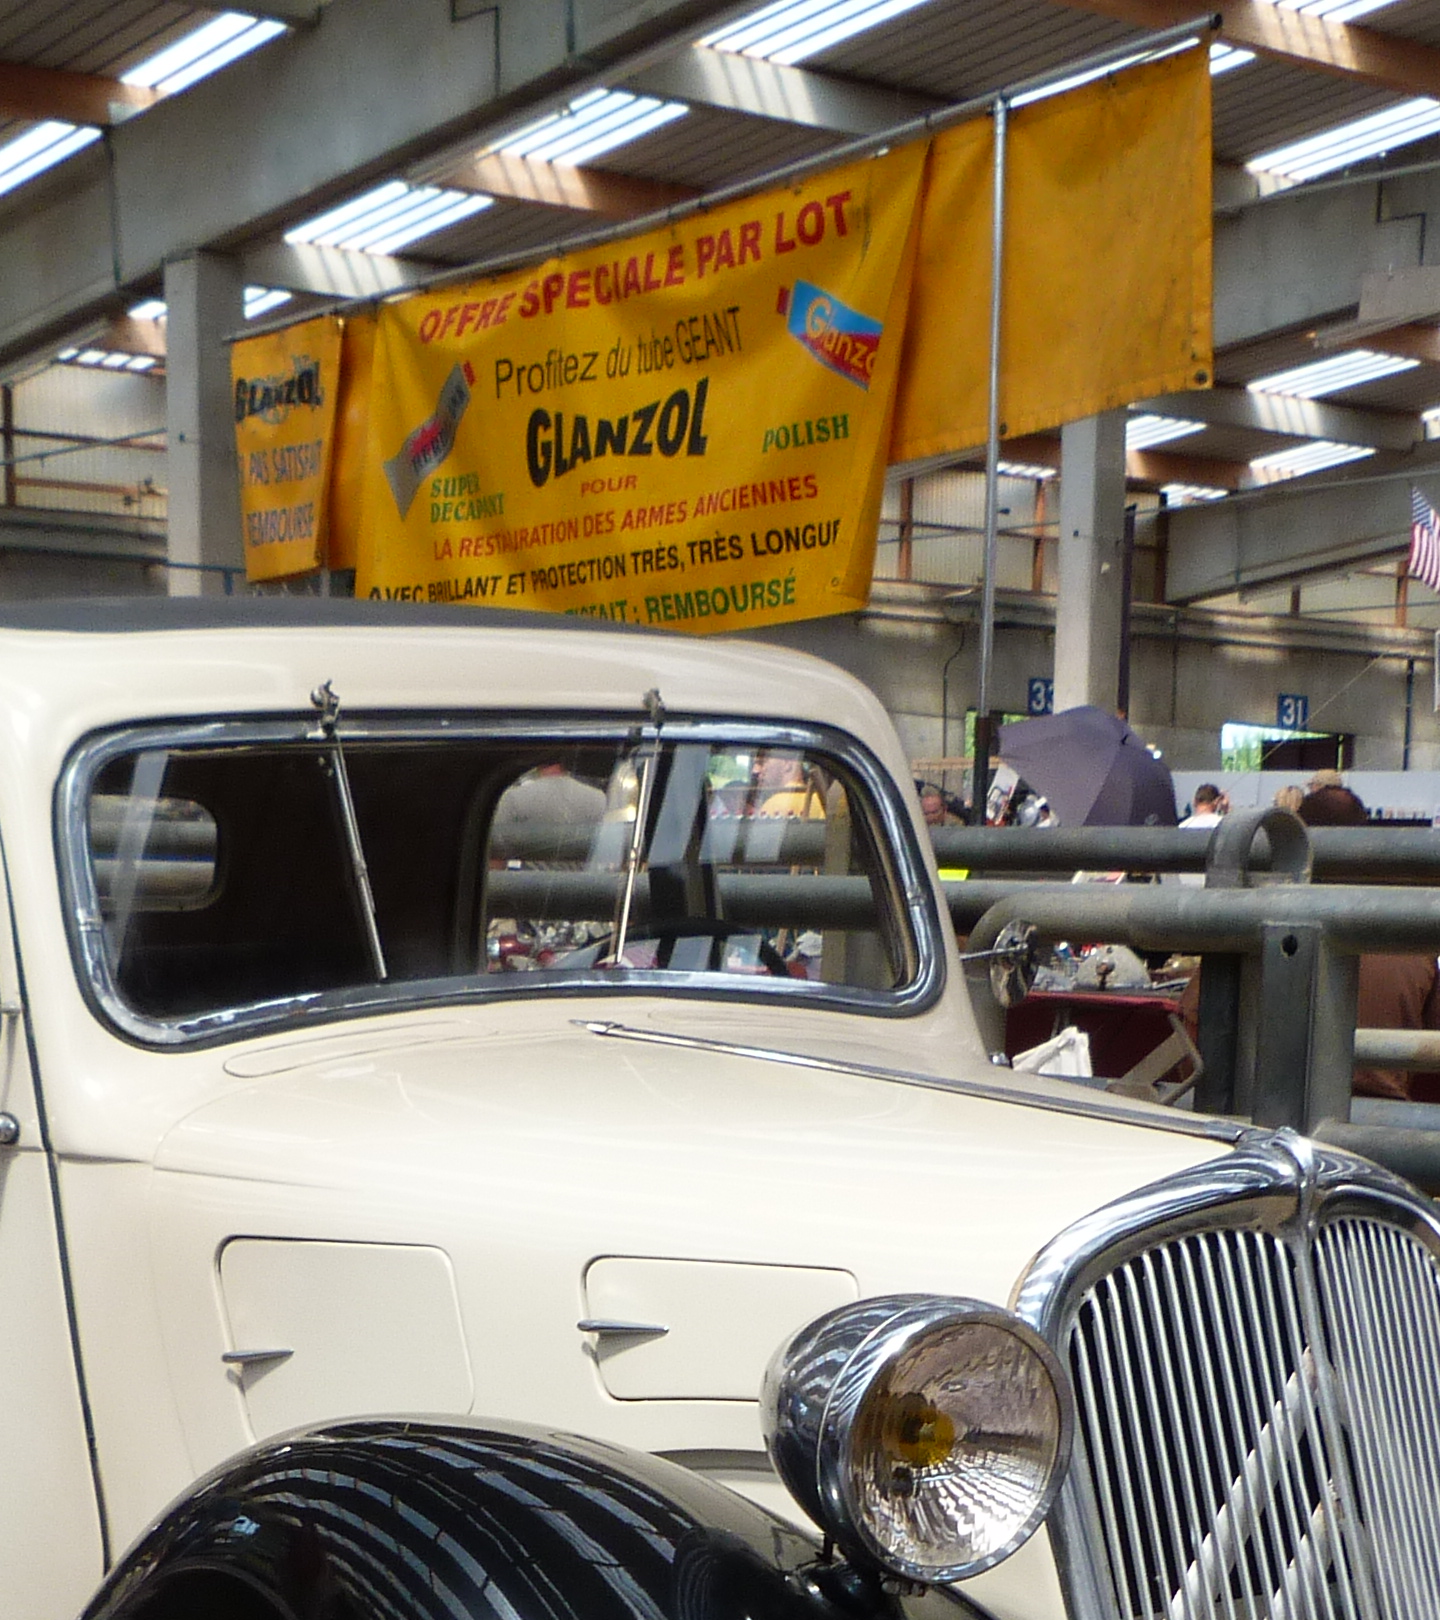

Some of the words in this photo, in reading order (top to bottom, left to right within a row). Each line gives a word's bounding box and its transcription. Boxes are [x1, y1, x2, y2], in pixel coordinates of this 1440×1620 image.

[419, 292, 517, 344] OFFRE
[518, 245, 684, 319] SPECIALE
[696, 220, 762, 279] PAR
[775, 190, 852, 255] LOT
[495, 349, 600, 399] Profitez
[606, 336, 632, 378] du
[637, 327, 675, 375] tube
[675, 305, 742, 364] GEANT
[526, 377, 709, 488] GLANZOL
[762, 413, 850, 453] POLISH
[433, 536, 453, 560] LA
[459, 523, 578, 558] RESTAURATION
[583, 510, 616, 538] DES
[620, 500, 687, 532] ARMES
[693, 474, 819, 518] ANCIENNES
[581, 474, 637, 498] POUR
[428, 575, 502, 601] BRILLANT
[506, 572, 526, 594] ET
[531, 553, 627, 592] PROTECTION
[630, 539, 685, 573] TRÈS,
[687, 530, 744, 566] TRÈS
[646, 568, 797, 623] REMBOURSÉ
[1282, 698, 1305, 725] 31
